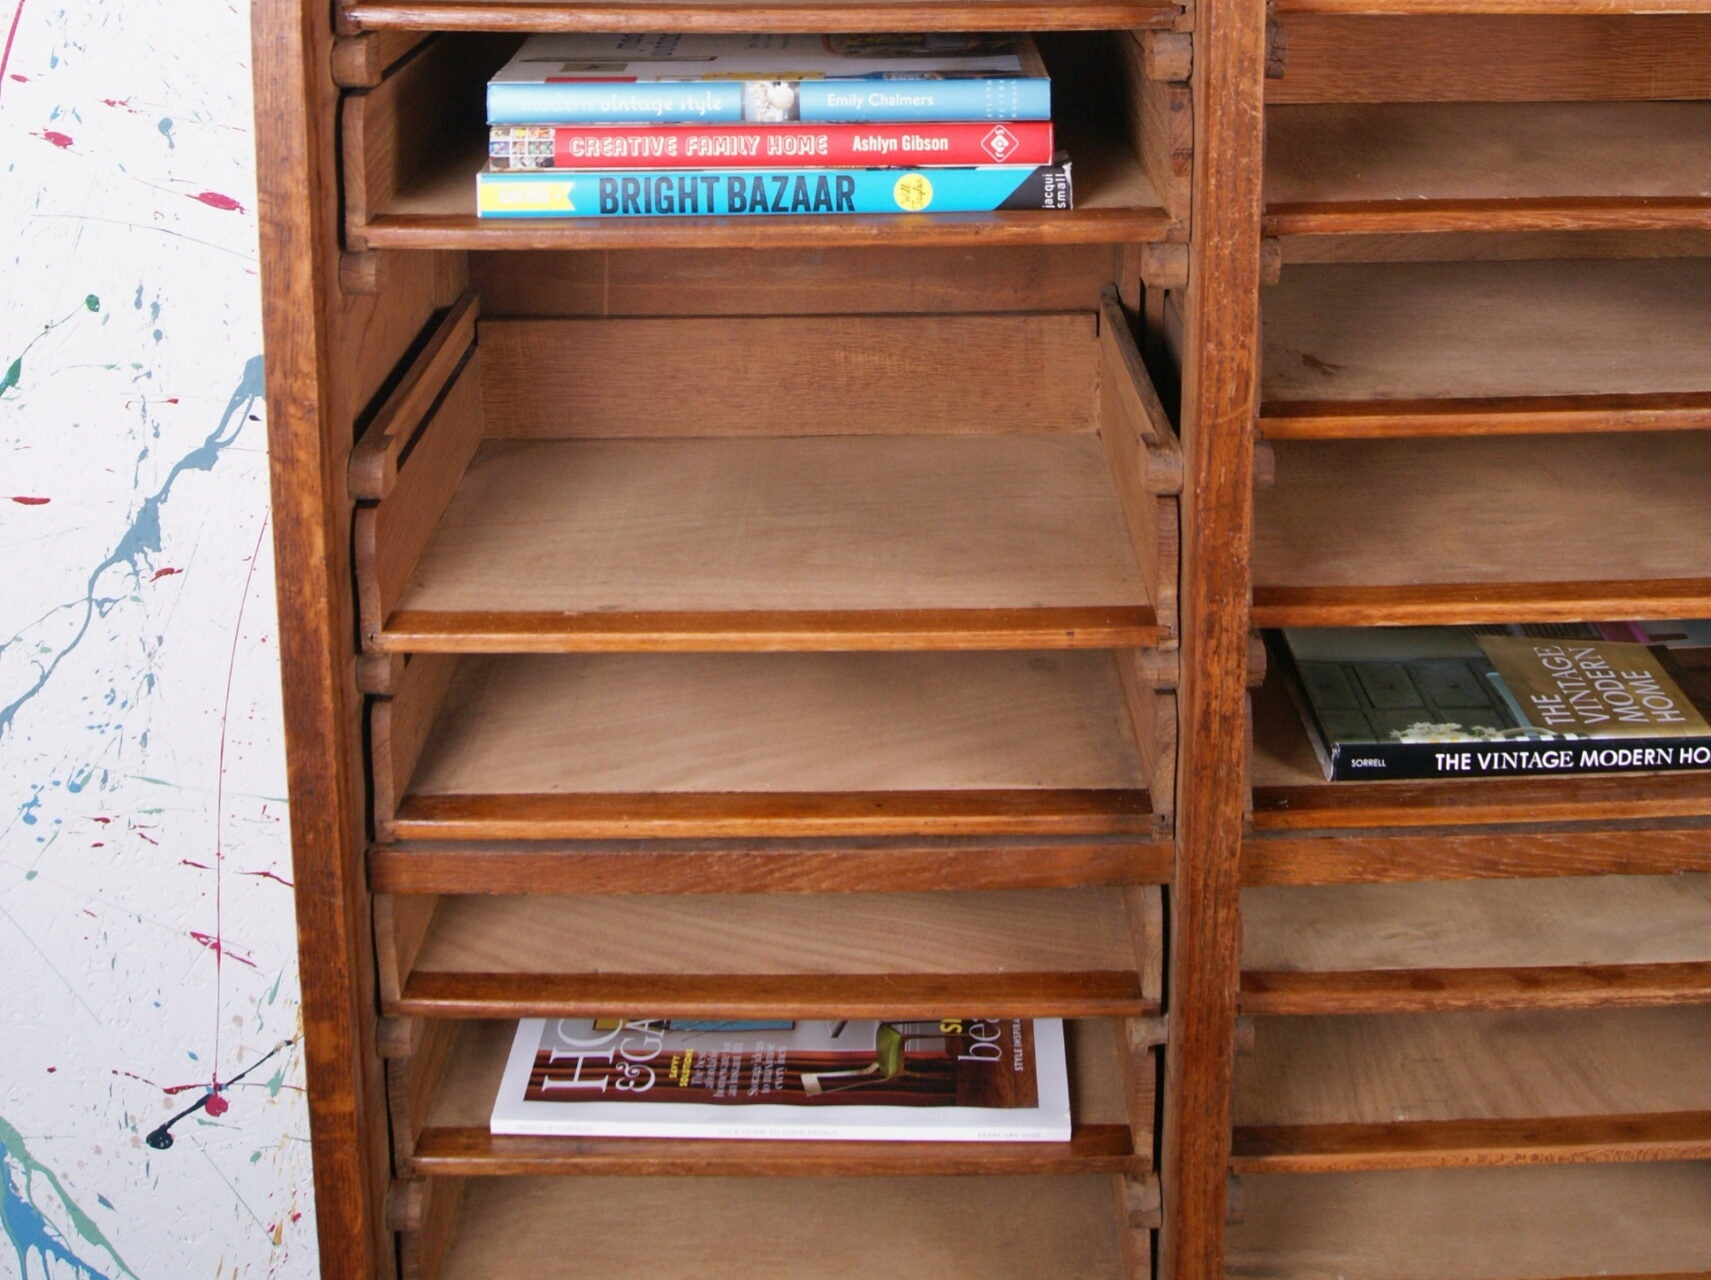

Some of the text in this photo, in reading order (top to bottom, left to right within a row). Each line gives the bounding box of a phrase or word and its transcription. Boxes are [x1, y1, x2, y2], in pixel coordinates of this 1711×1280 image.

[520, 91, 722, 115] modern vintage style
[827, 93, 935, 110] Emily Chalmers
[569, 135, 828, 157] CREATIVE FAMILY HOME
[852, 134, 949, 153] Ashlyn Gibson
[600, 175, 856, 214] BRIGHT BAZAAR
[1042, 173, 1055, 209] jacqui
[1056, 173, 1067, 209] small
[1534, 645, 1611, 724] VINTAGE
[1567, 646, 1650, 723] MODERN
[1621, 670, 1686, 723] HOME
[1530, 693, 1576, 725] THE
[1351, 758, 1386, 768] SORRELL
[1435, 746, 1711, 771] THE VINTAGE MODERN HO
[1013, 1048, 1023, 1072] STYLE
[615, 1061, 656, 1093] &
